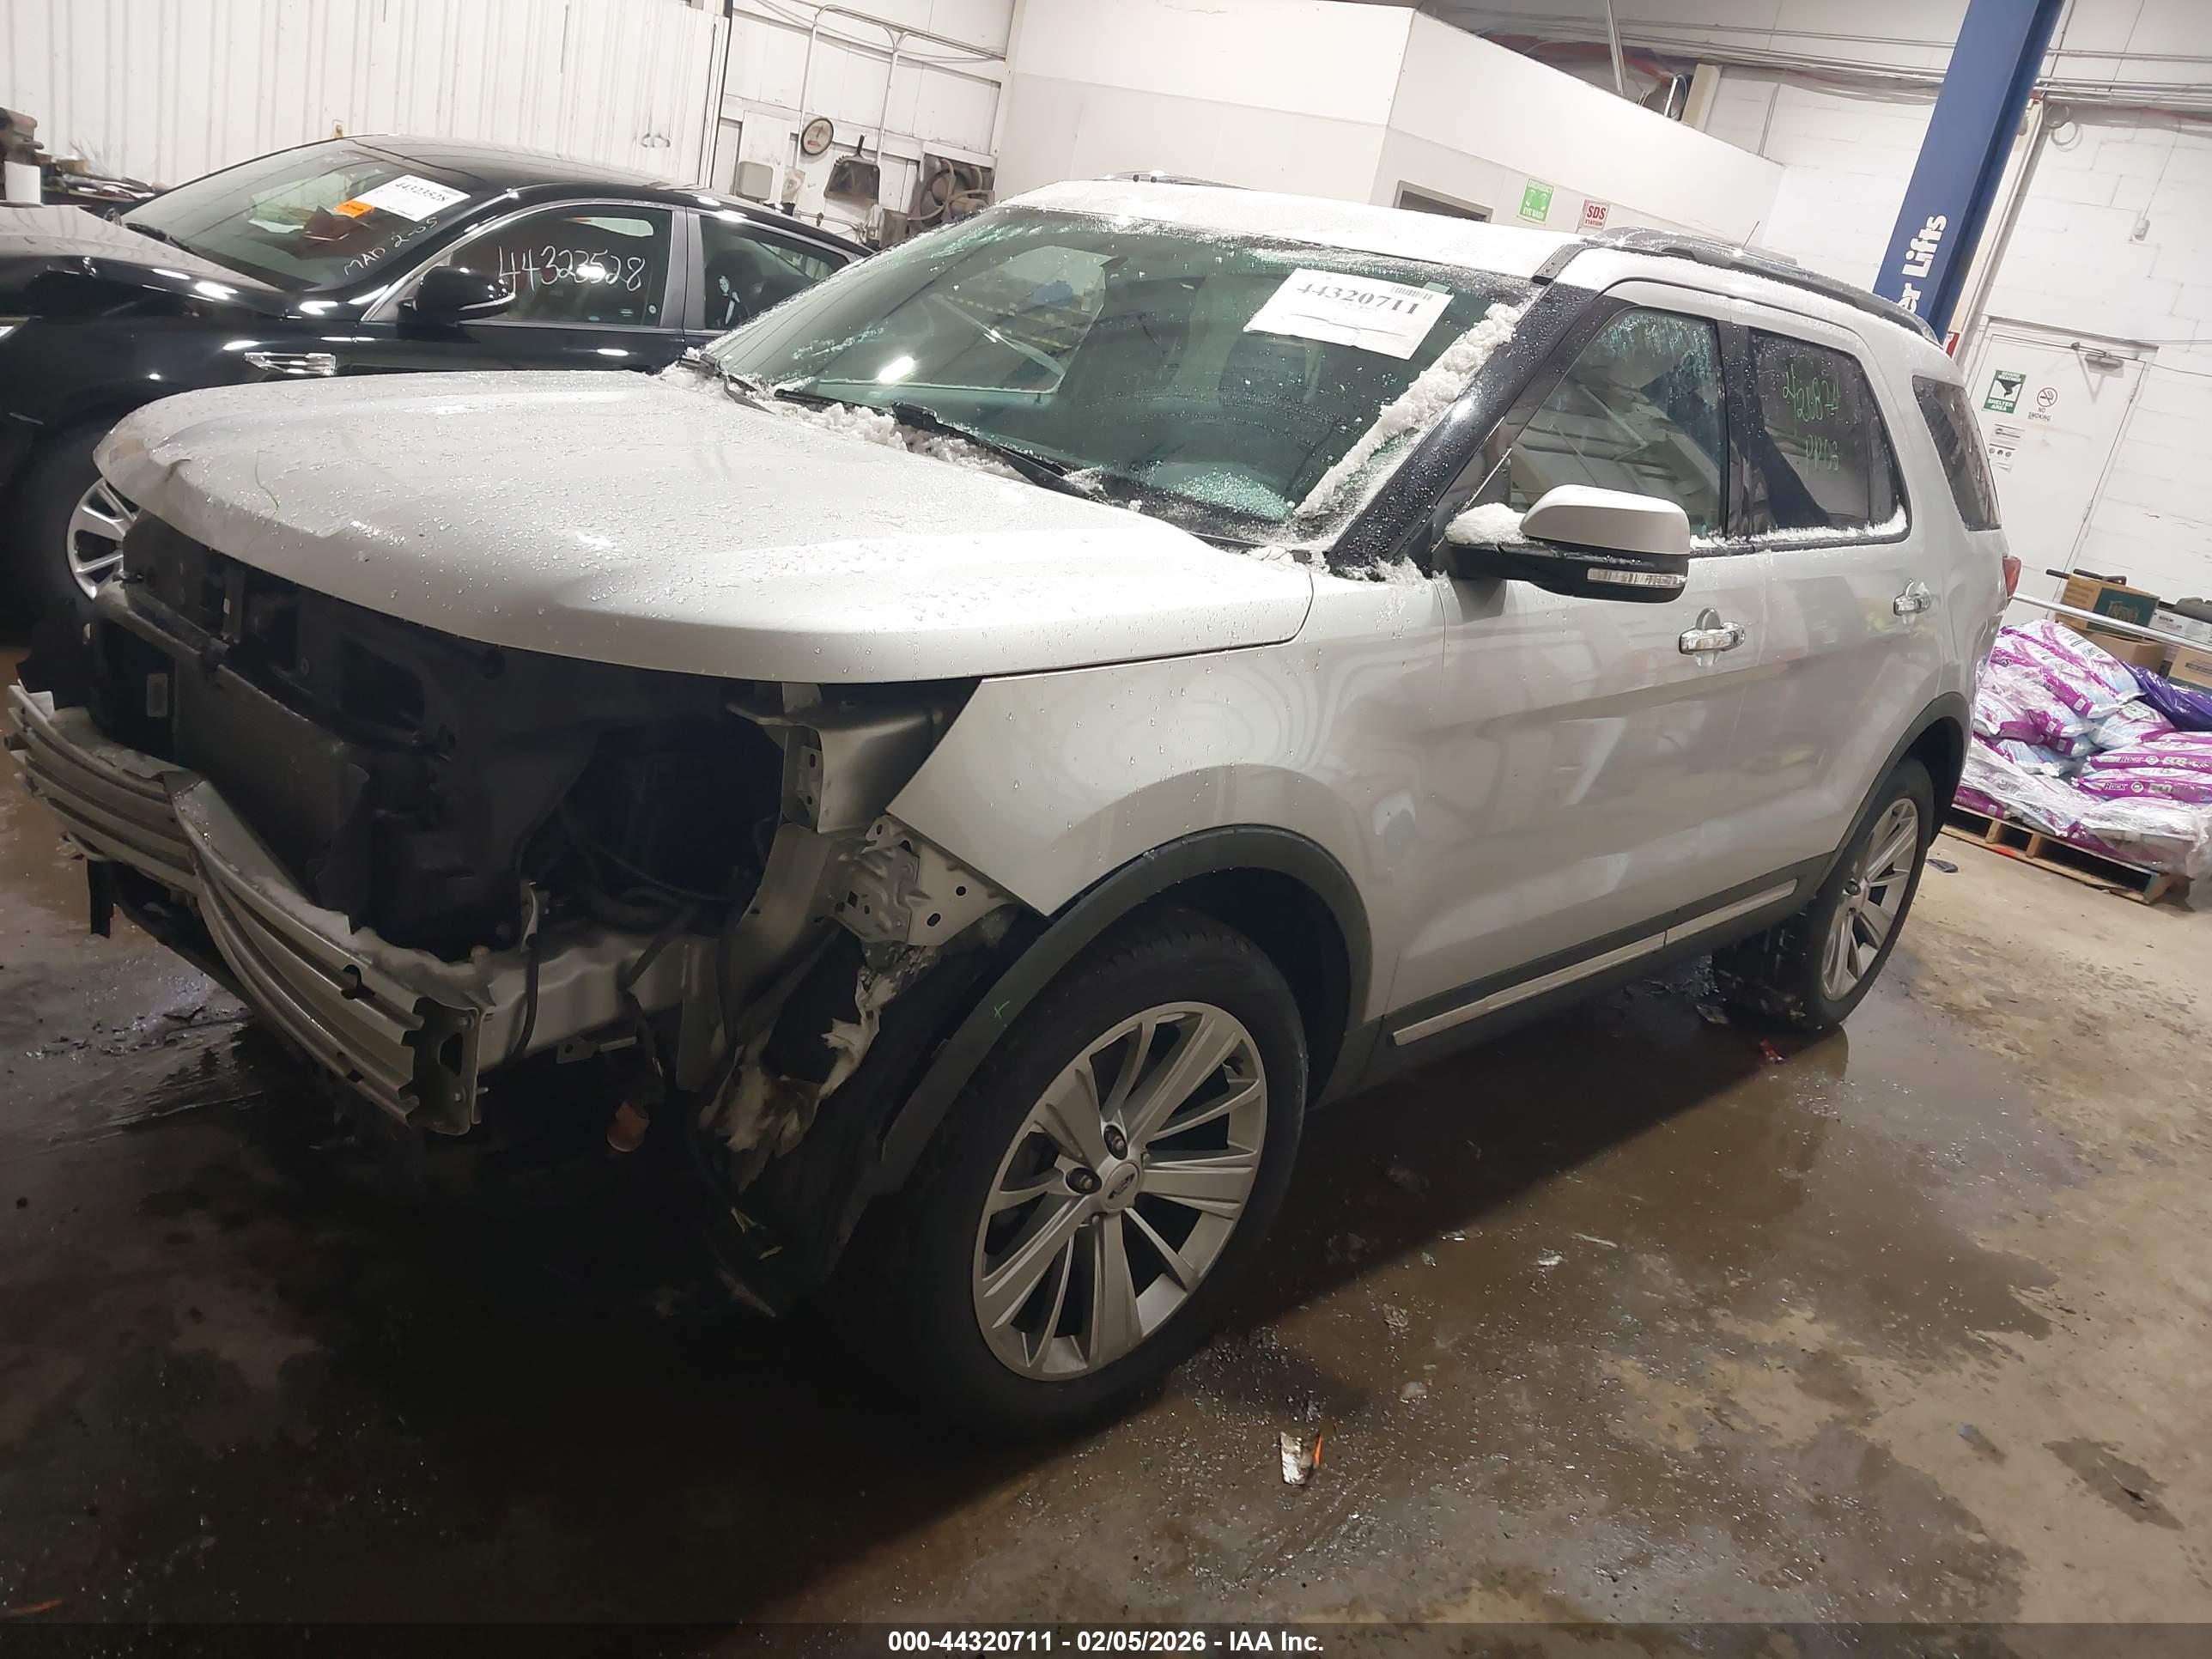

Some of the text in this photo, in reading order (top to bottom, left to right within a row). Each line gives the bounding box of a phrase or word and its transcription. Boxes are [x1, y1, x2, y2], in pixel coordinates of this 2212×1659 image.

[1587, 204, 1607, 220] SDS
[1901, 215, 1948, 278] Lifts
[1297, 283, 1419, 315] 44320711
[2027, 411, 2051, 422] SMOKING
